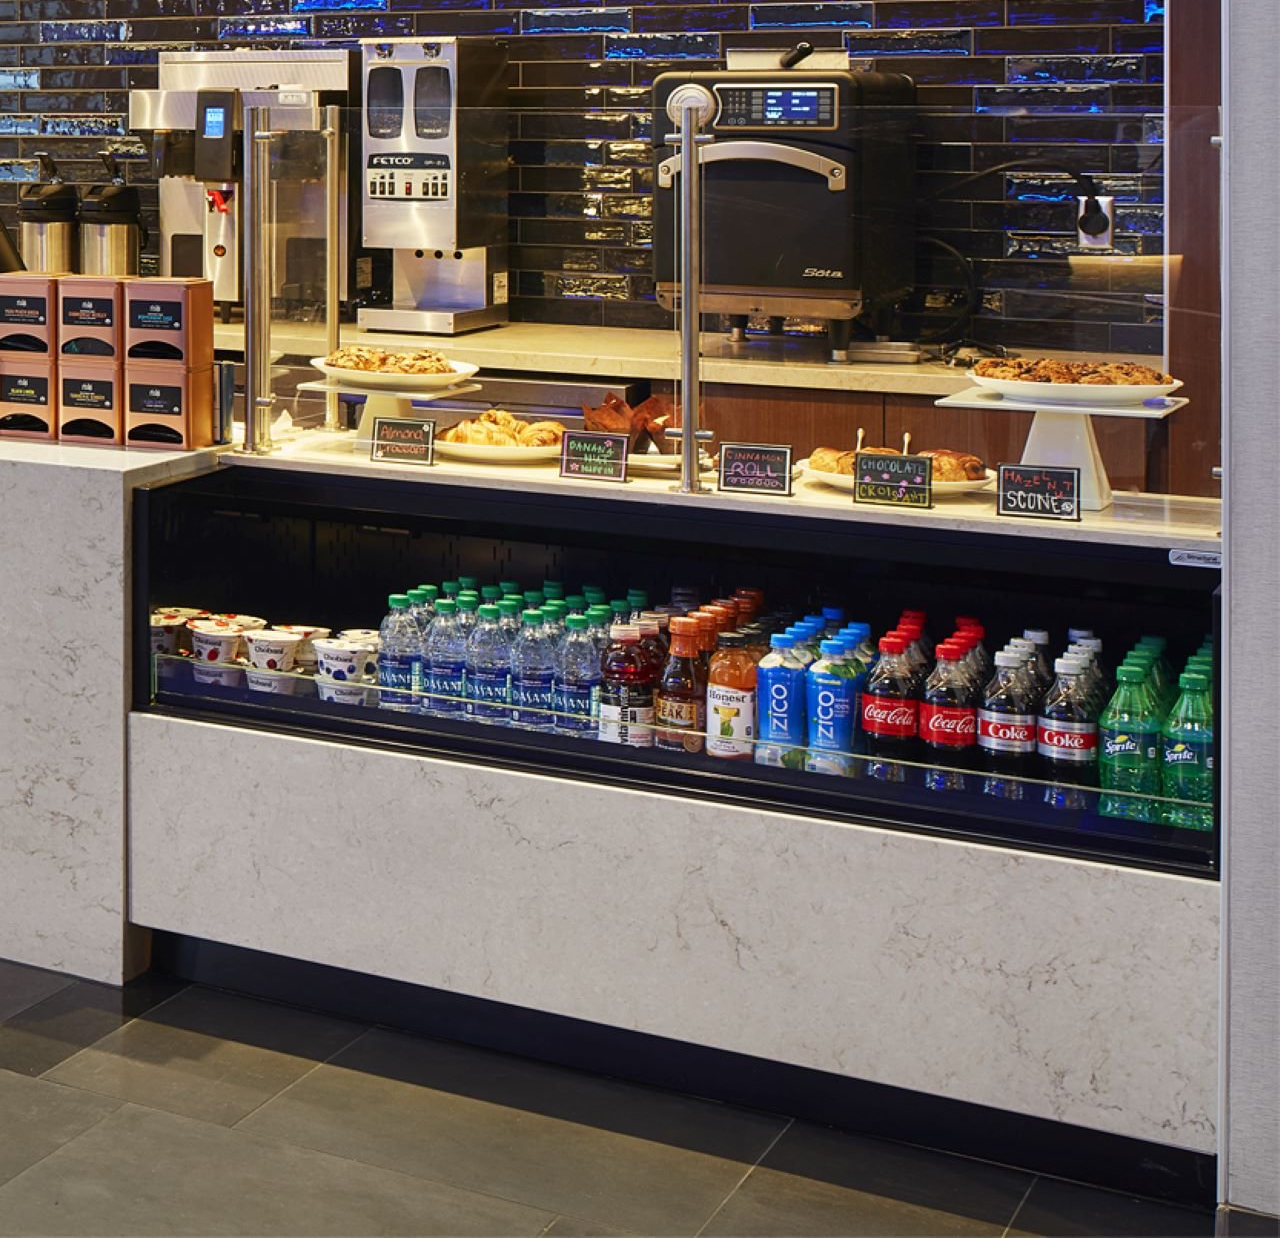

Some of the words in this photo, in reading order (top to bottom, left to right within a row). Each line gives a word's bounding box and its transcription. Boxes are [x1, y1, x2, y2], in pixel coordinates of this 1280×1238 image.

[372, 157, 411, 165] FETCO
[726, 450, 784, 461] CINNAMON
[731, 461, 777, 477] ROLL
[861, 458, 926, 476] CHOCOLATE
[1004, 469, 1073, 500] HAZELNUT
[860, 484, 926, 504] CROISSANT
[1007, 490, 1061, 513] SCONE
[467, 682, 507, 698] DASANI
[513, 690, 551, 703] DASANI
[709, 689, 746, 704] Honest
[864, 704, 915, 726] Coca-Cola
[988, 722, 1028, 740] Coke
[1043, 730, 1084, 748] Coke
[1104, 740, 1137, 754] Sprite
[1165, 749, 1194, 763] Sprite
